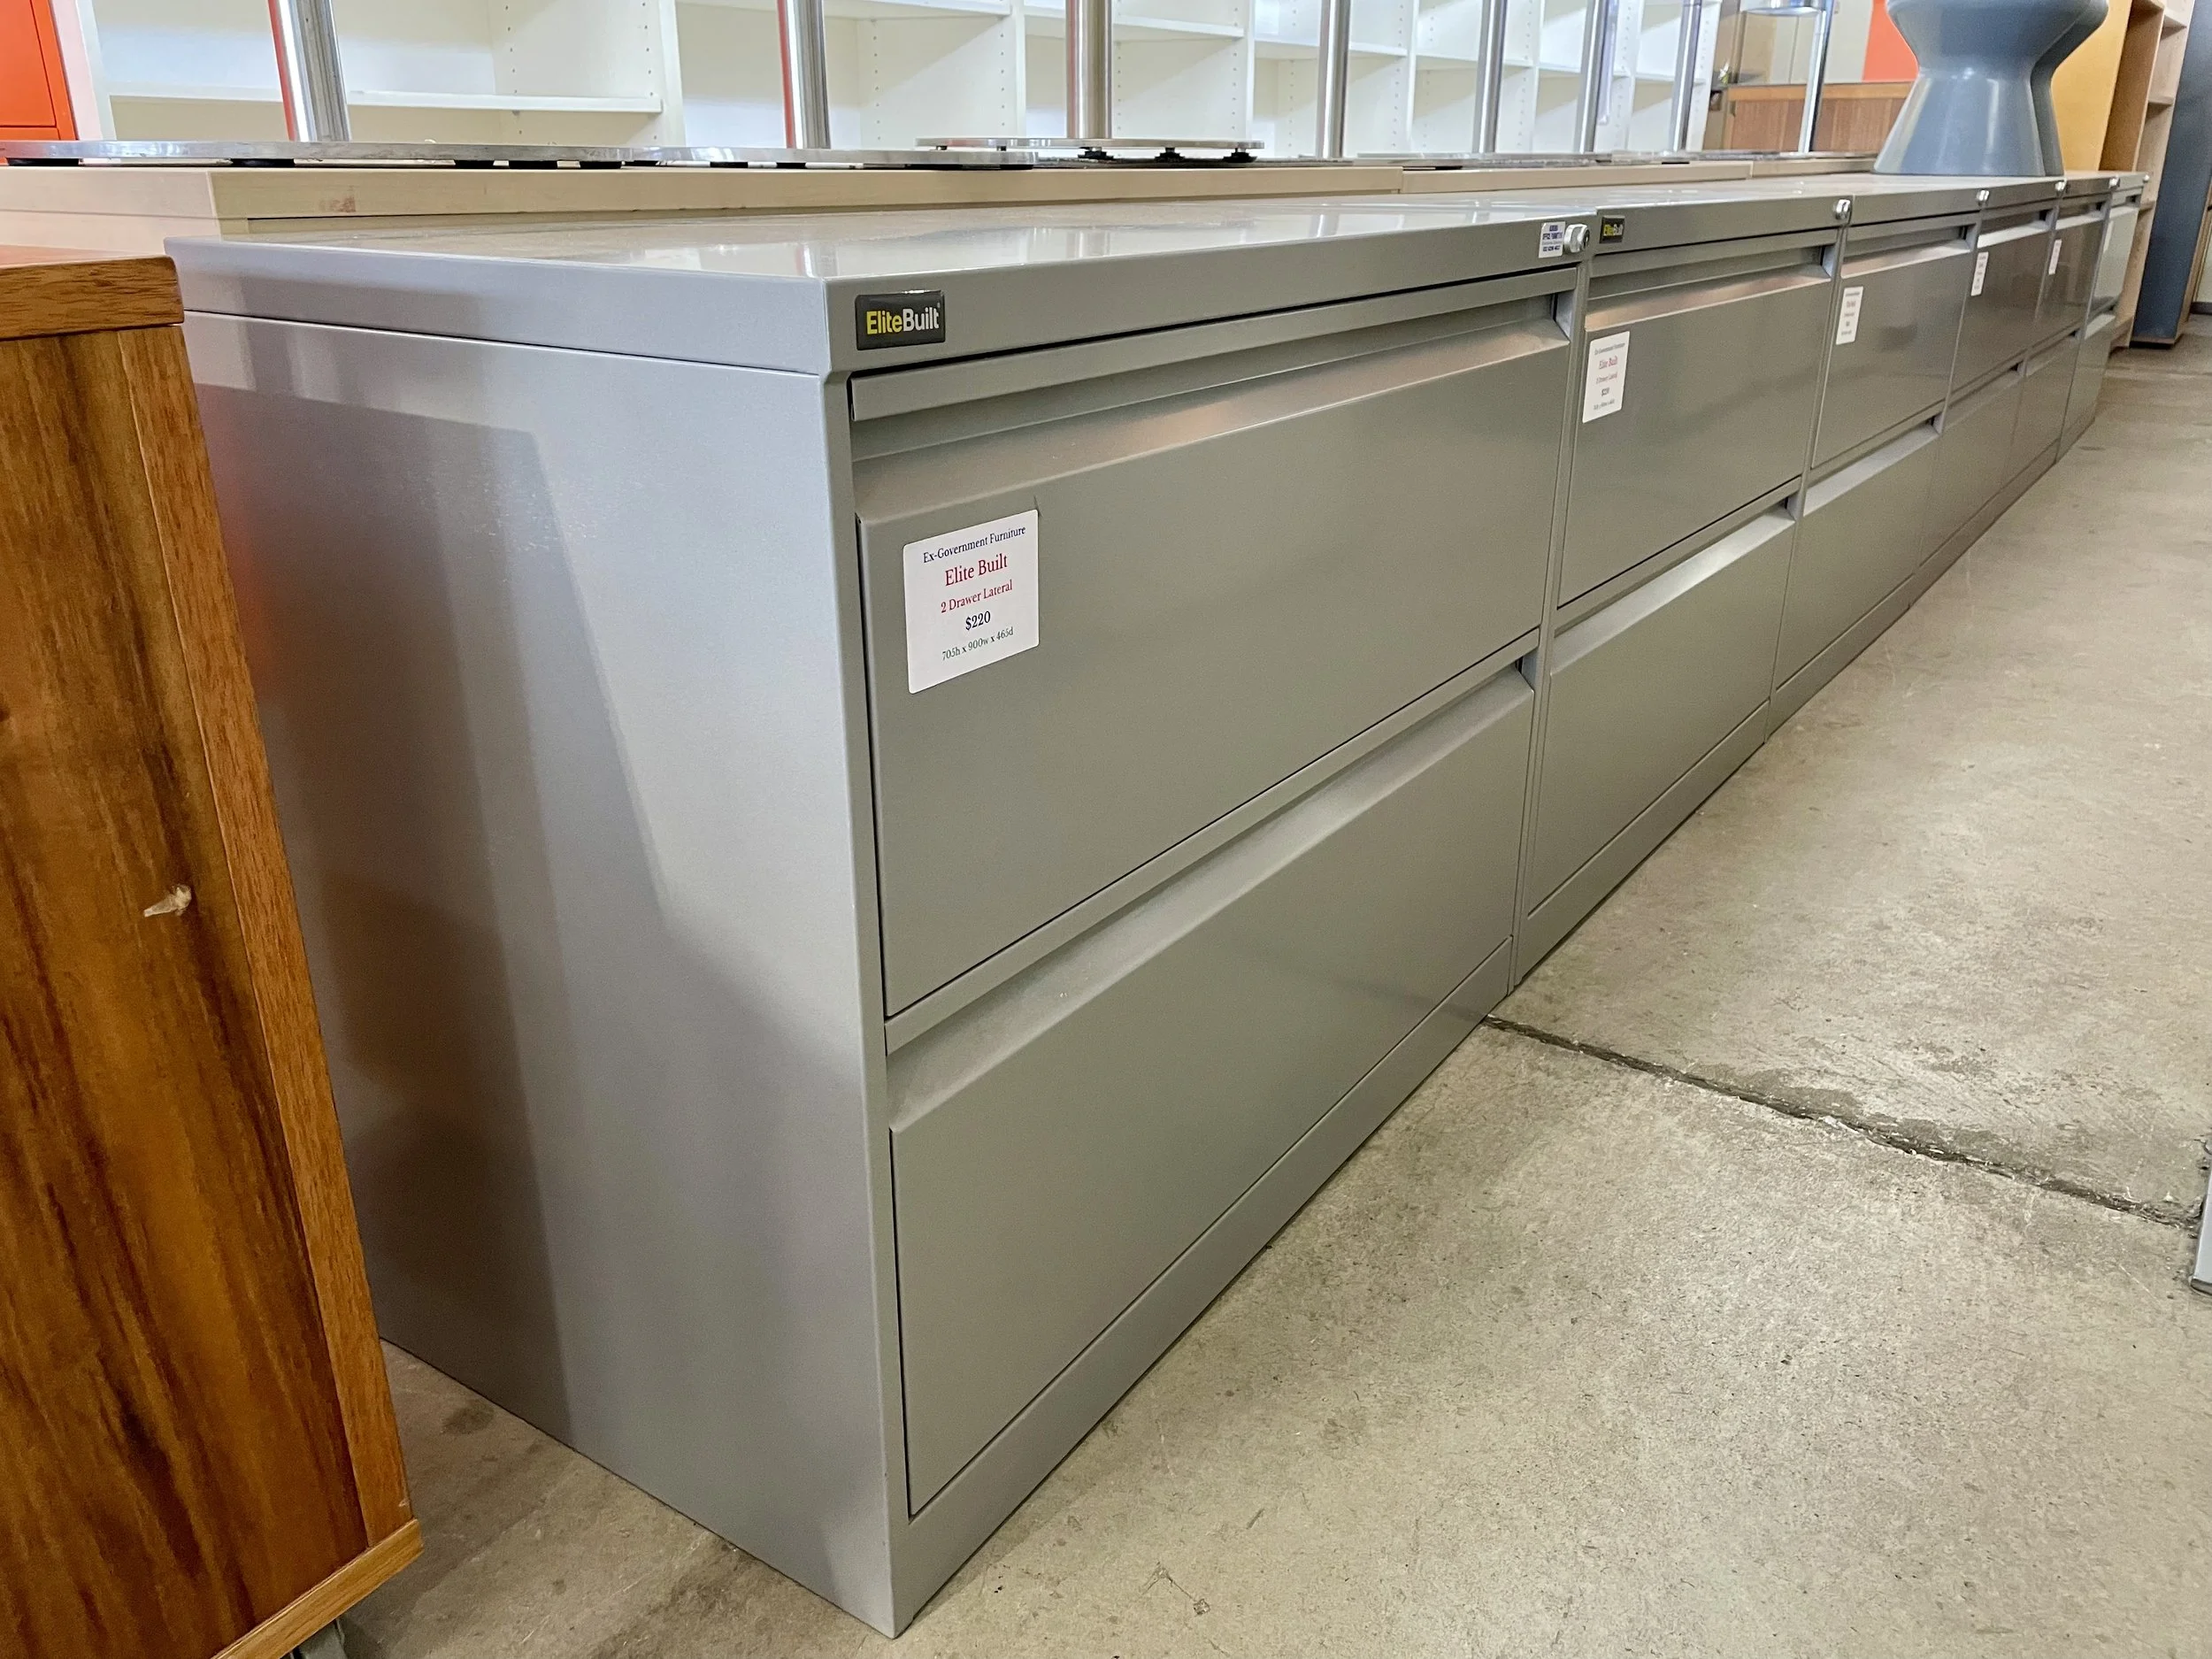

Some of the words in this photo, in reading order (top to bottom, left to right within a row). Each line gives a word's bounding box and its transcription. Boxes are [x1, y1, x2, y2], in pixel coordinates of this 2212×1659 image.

[923, 536, 988, 564] Ex-Government
[989, 526, 1026, 544] Furniture
[944, 565, 975, 587] Elite
[978, 552, 1009, 576] Built
[941, 602, 948, 614] 2
[949, 592, 982, 611] Drawer
[983, 579, 1013, 600] Lateral
[965, 611, 991, 631] $220
[941, 644, 961, 661] 705h
[962, 645, 967, 654] x
[968, 636, 989, 651] 900w
[996, 626, 1014, 640] 465d
